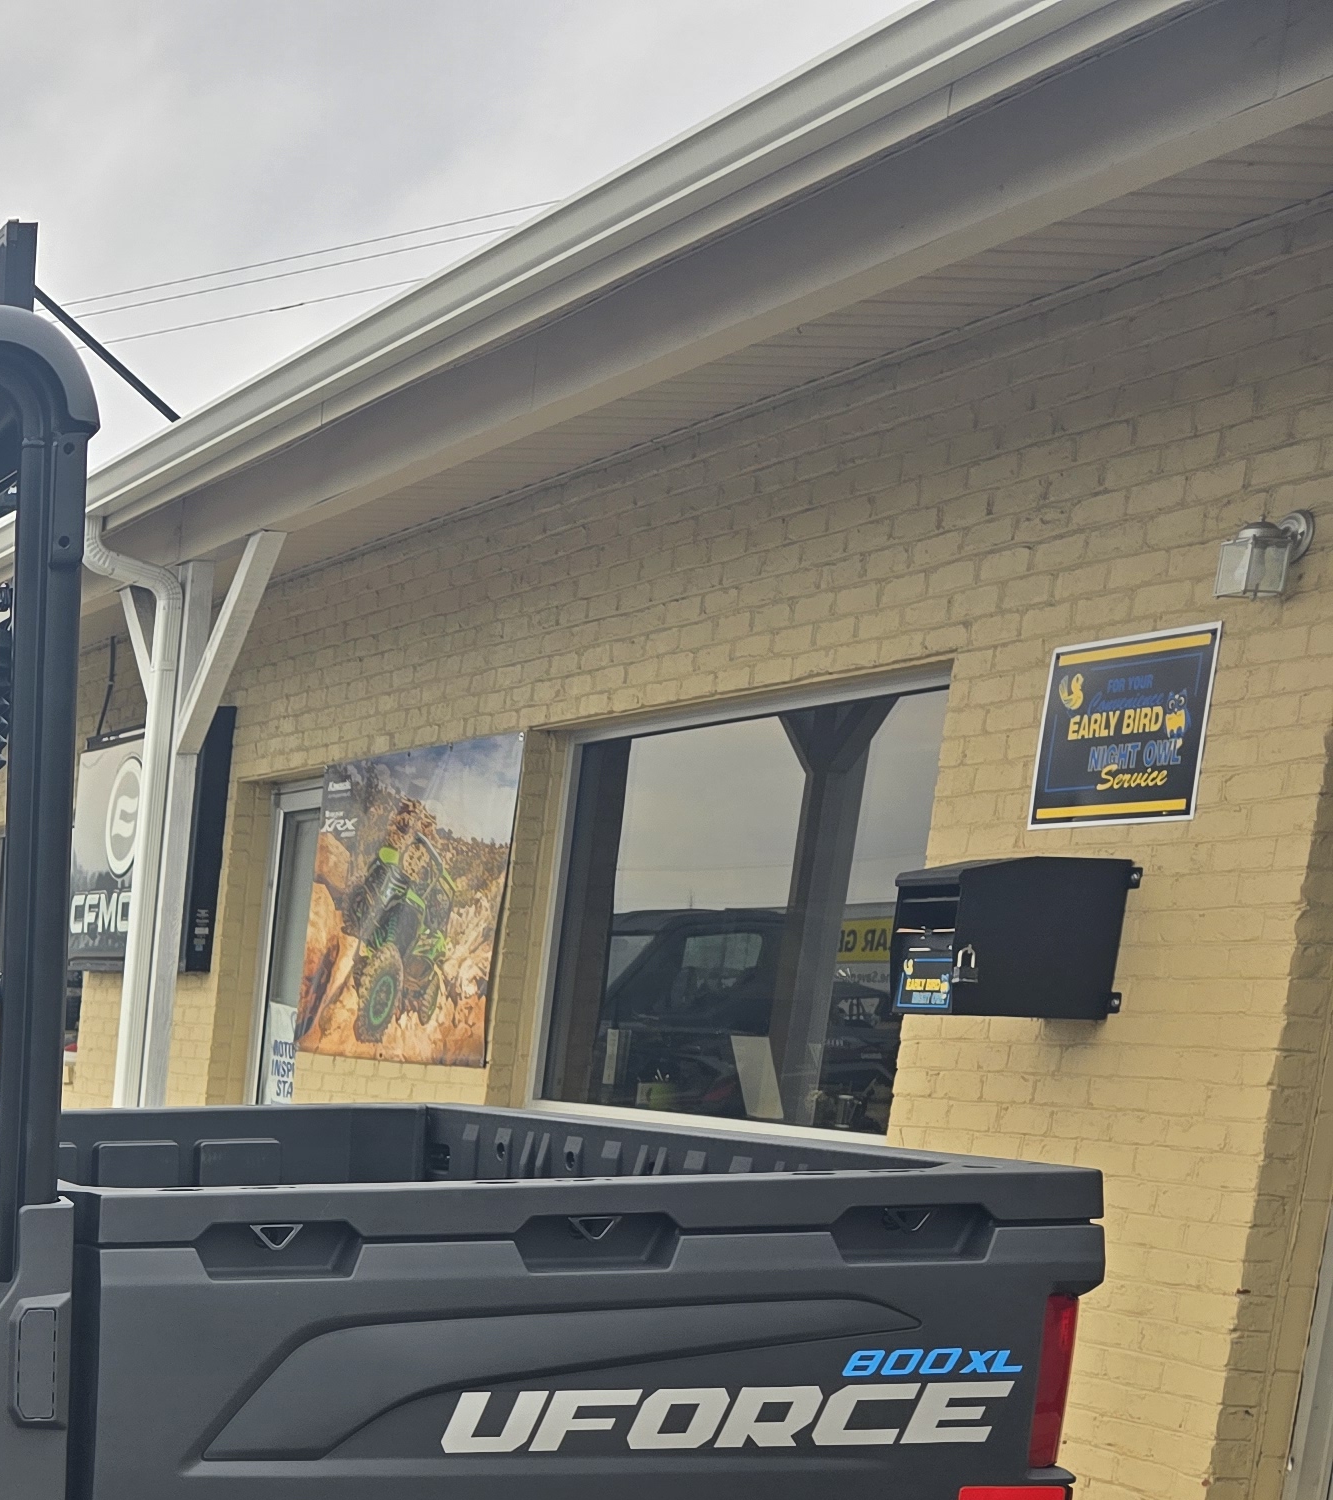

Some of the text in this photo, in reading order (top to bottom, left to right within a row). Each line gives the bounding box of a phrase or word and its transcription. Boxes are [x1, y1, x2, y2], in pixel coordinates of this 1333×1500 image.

[1107, 673, 1154, 693] FOR YOUR
[1087, 690, 1164, 716] Convenience
[1067, 705, 1164, 741] EARLY BIRD
[1087, 737, 1182, 772] NIGHT OWL
[1096, 764, 1168, 790] Service
[842, 1346, 1024, 1378] 800XL
[440, 1380, 1016, 1454] UFORCE
